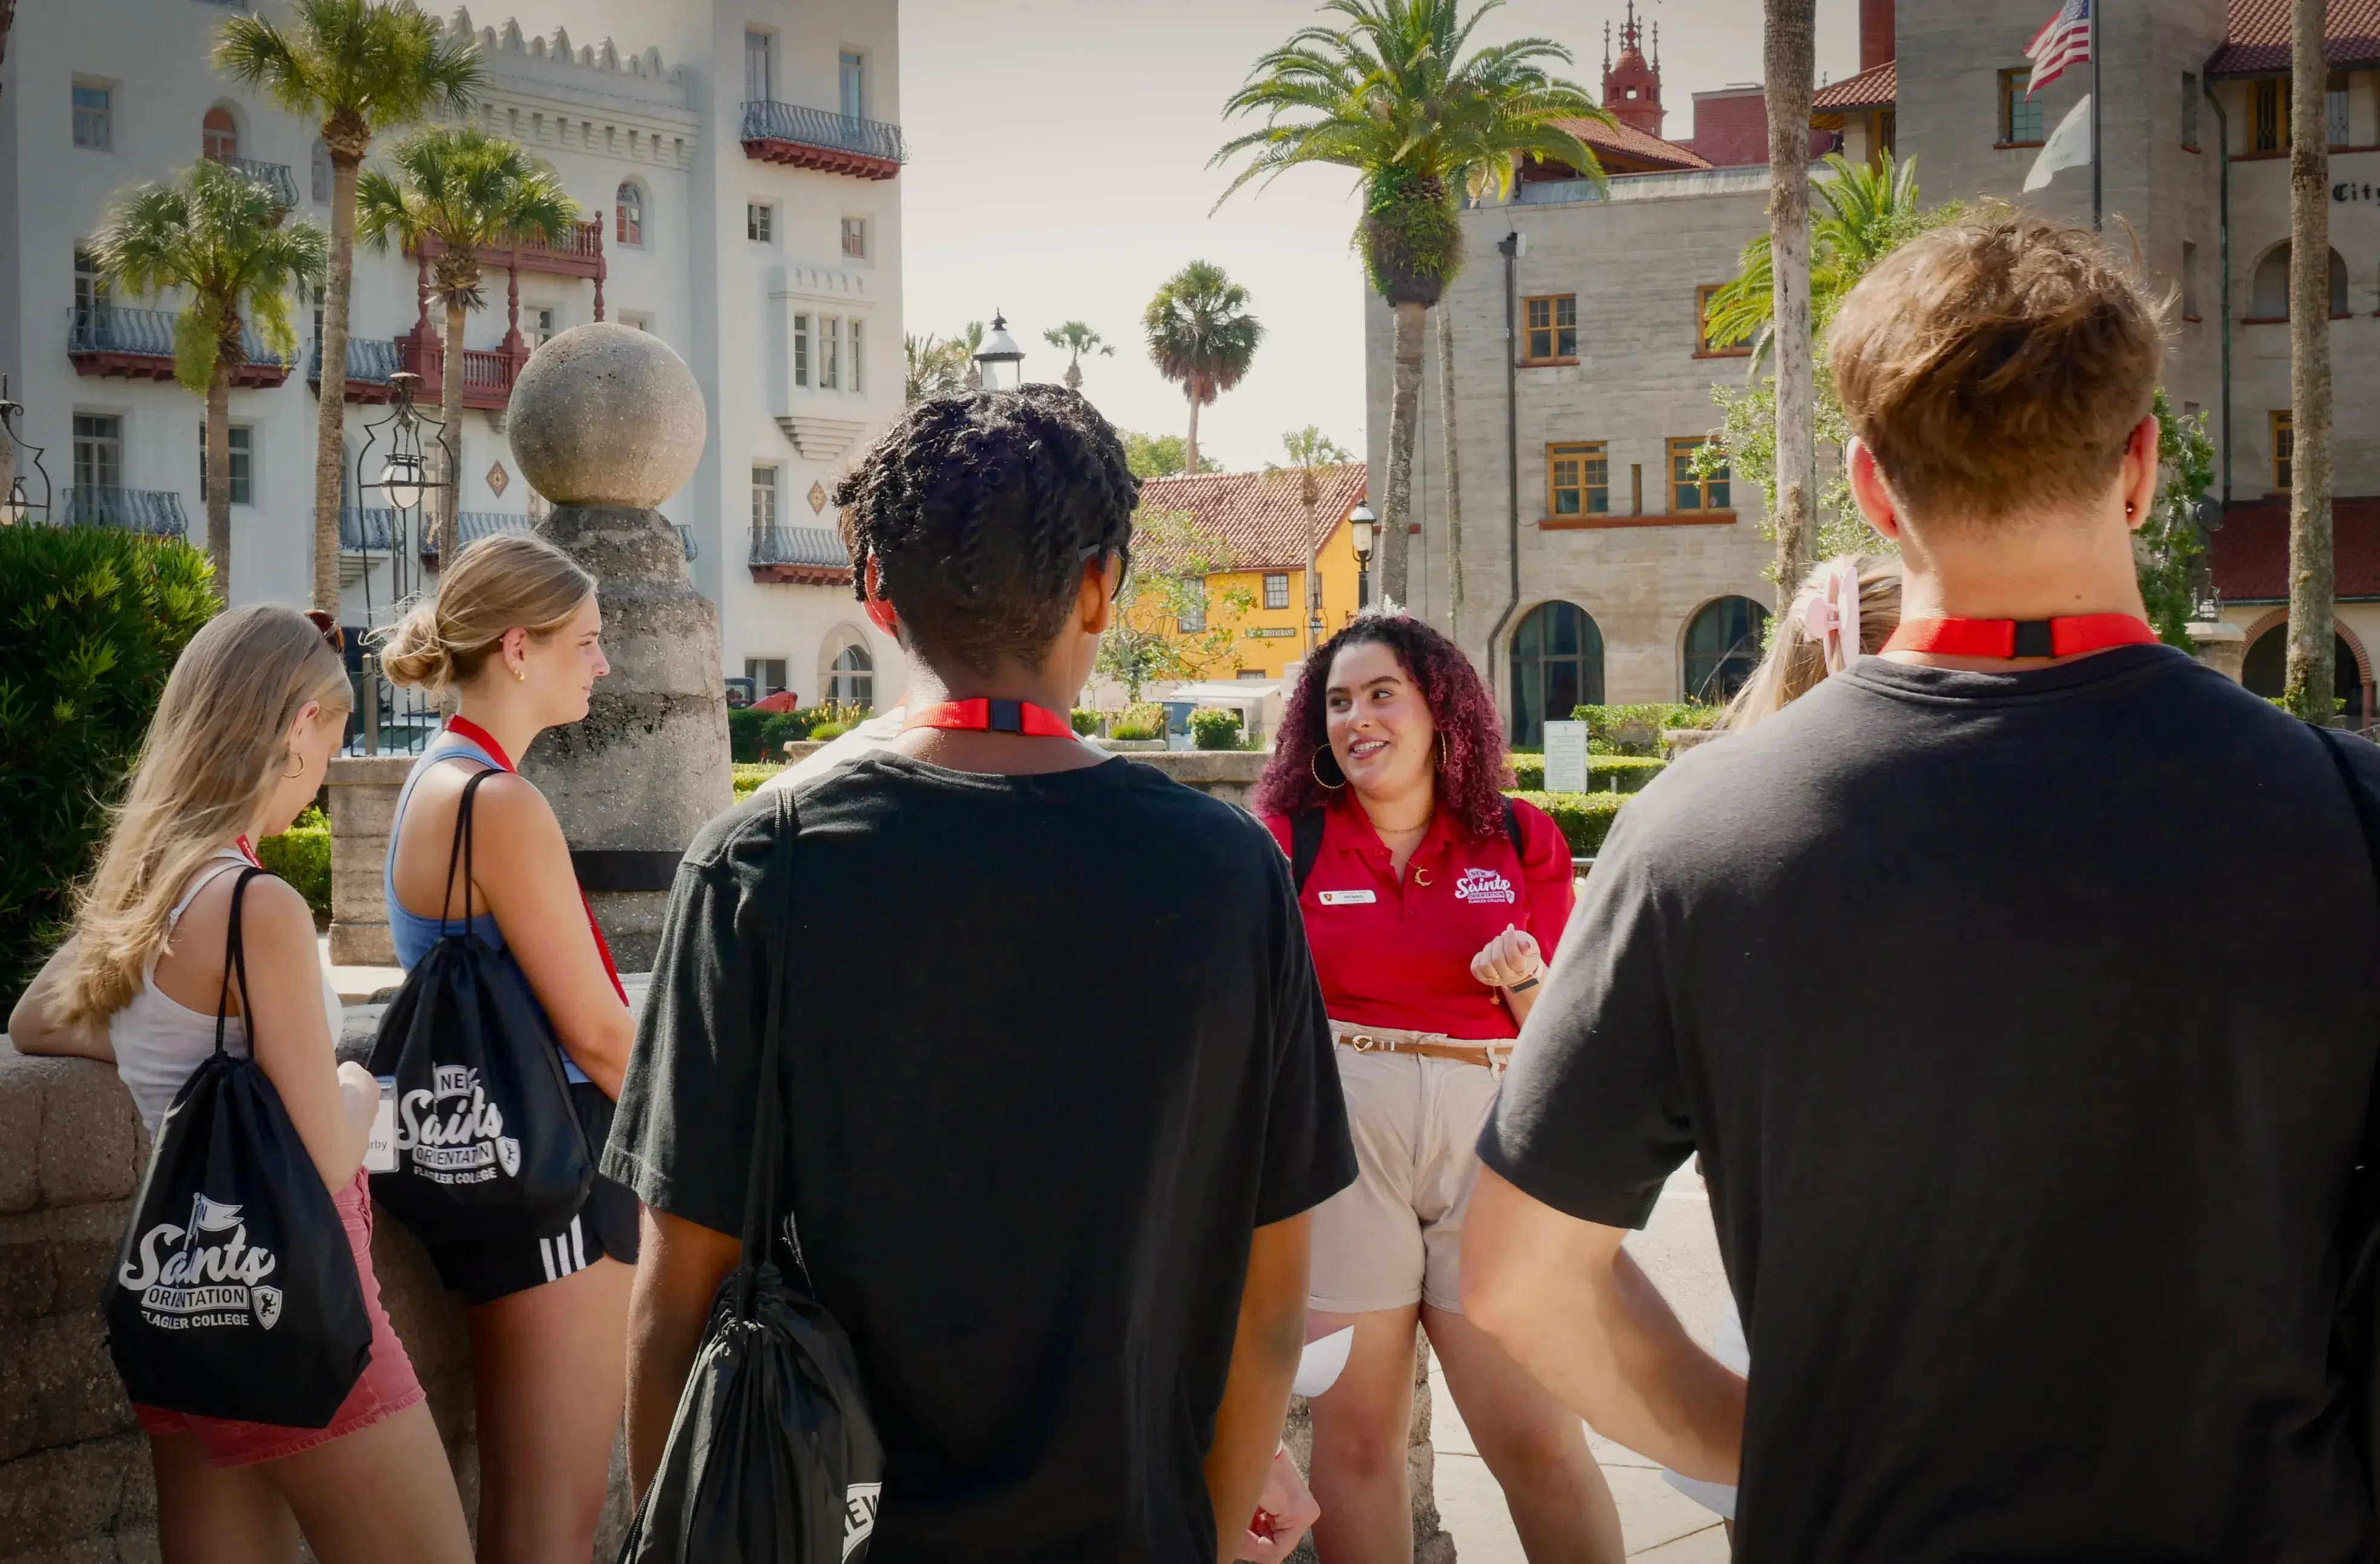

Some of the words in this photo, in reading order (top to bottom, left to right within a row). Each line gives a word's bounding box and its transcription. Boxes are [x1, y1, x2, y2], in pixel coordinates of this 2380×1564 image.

[1455, 874, 1511, 899] Saints
[370, 1140, 387, 1151] rby
[416, 1145, 490, 1165] ORIENTATN
[455, 1167, 498, 1184] COLEGE
[192, 1313, 249, 1327] COLLEGE
[843, 1495, 879, 1538] EW
